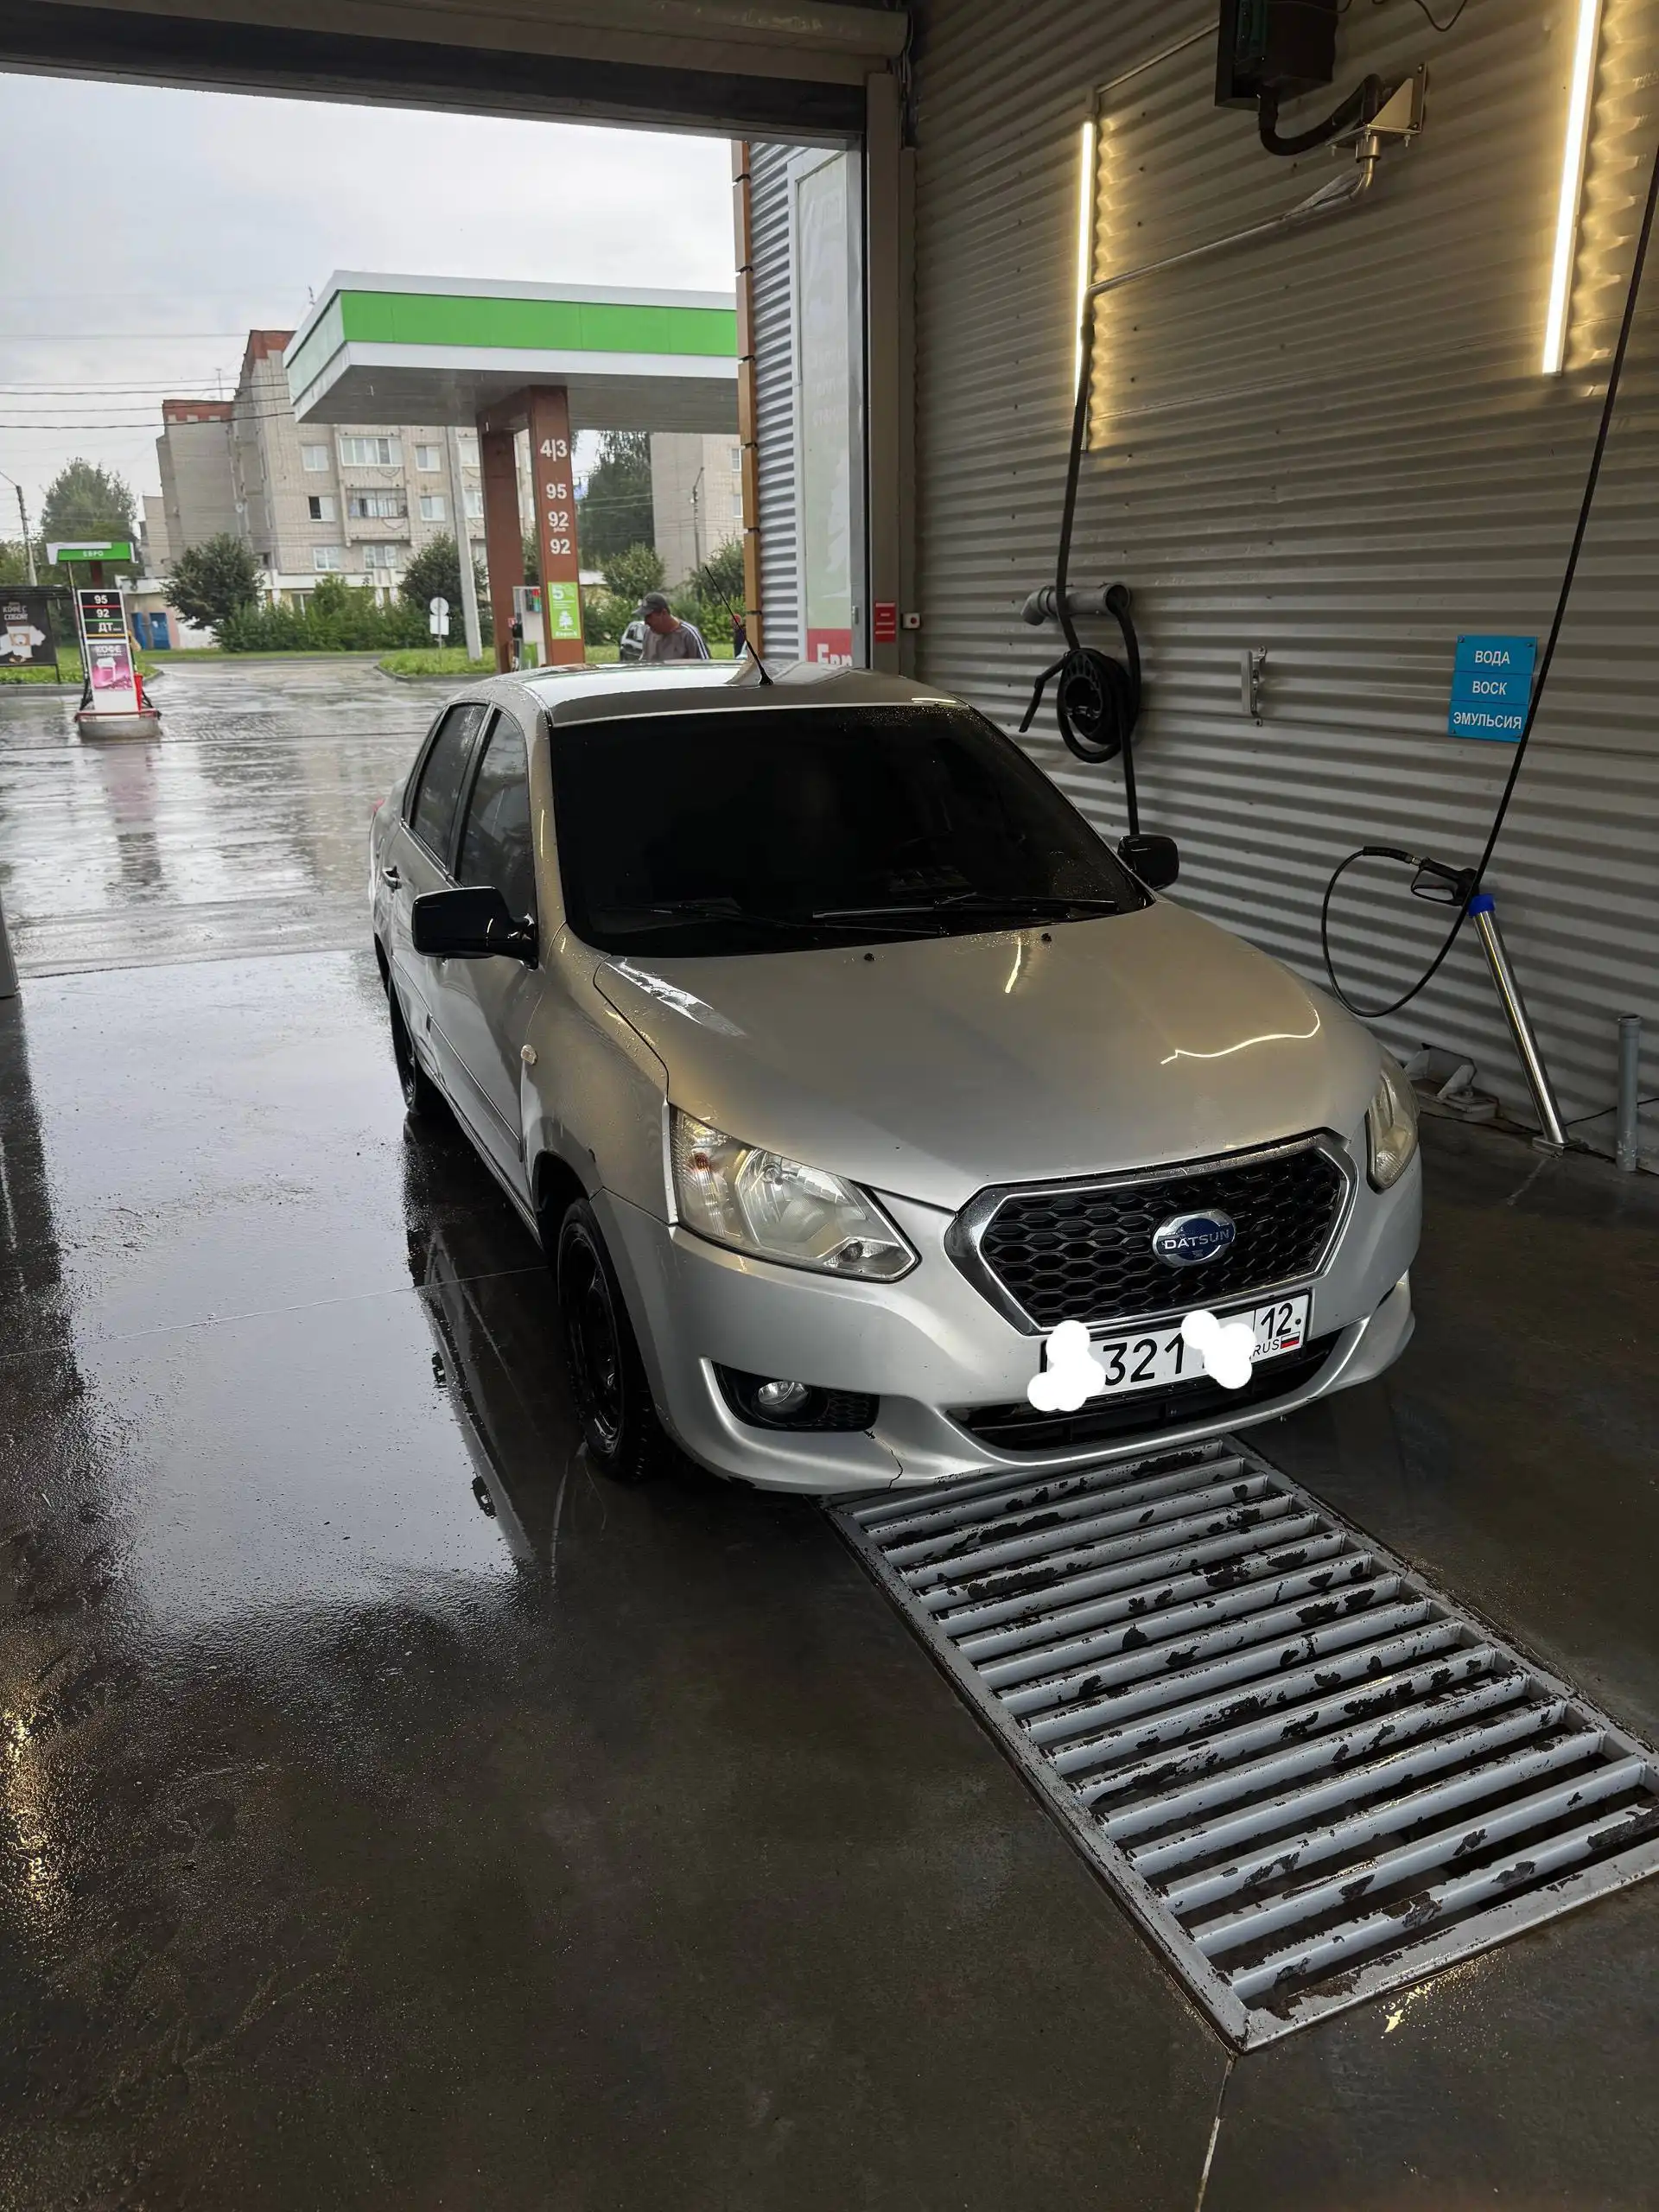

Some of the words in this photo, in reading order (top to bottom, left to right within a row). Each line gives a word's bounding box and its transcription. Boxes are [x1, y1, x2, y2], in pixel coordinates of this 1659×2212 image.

[546, 483, 568, 499] 95
[548, 512, 569, 527] 92
[550, 539, 571, 555] 92
[94, 594, 108, 605] 95
[96, 608, 110, 618] 92
[98, 622, 113, 633] ДТ
[1475, 650, 1510, 666] ВОДА
[1472, 681, 1507, 696] ВОСК
[1452, 711, 1522, 729] ЭМУЛЬСИЯ
[1164, 1229, 1230, 1249] DATSUN
[1261, 1302, 1294, 1339] 12
[1252, 1338, 1280, 1356] RUS
